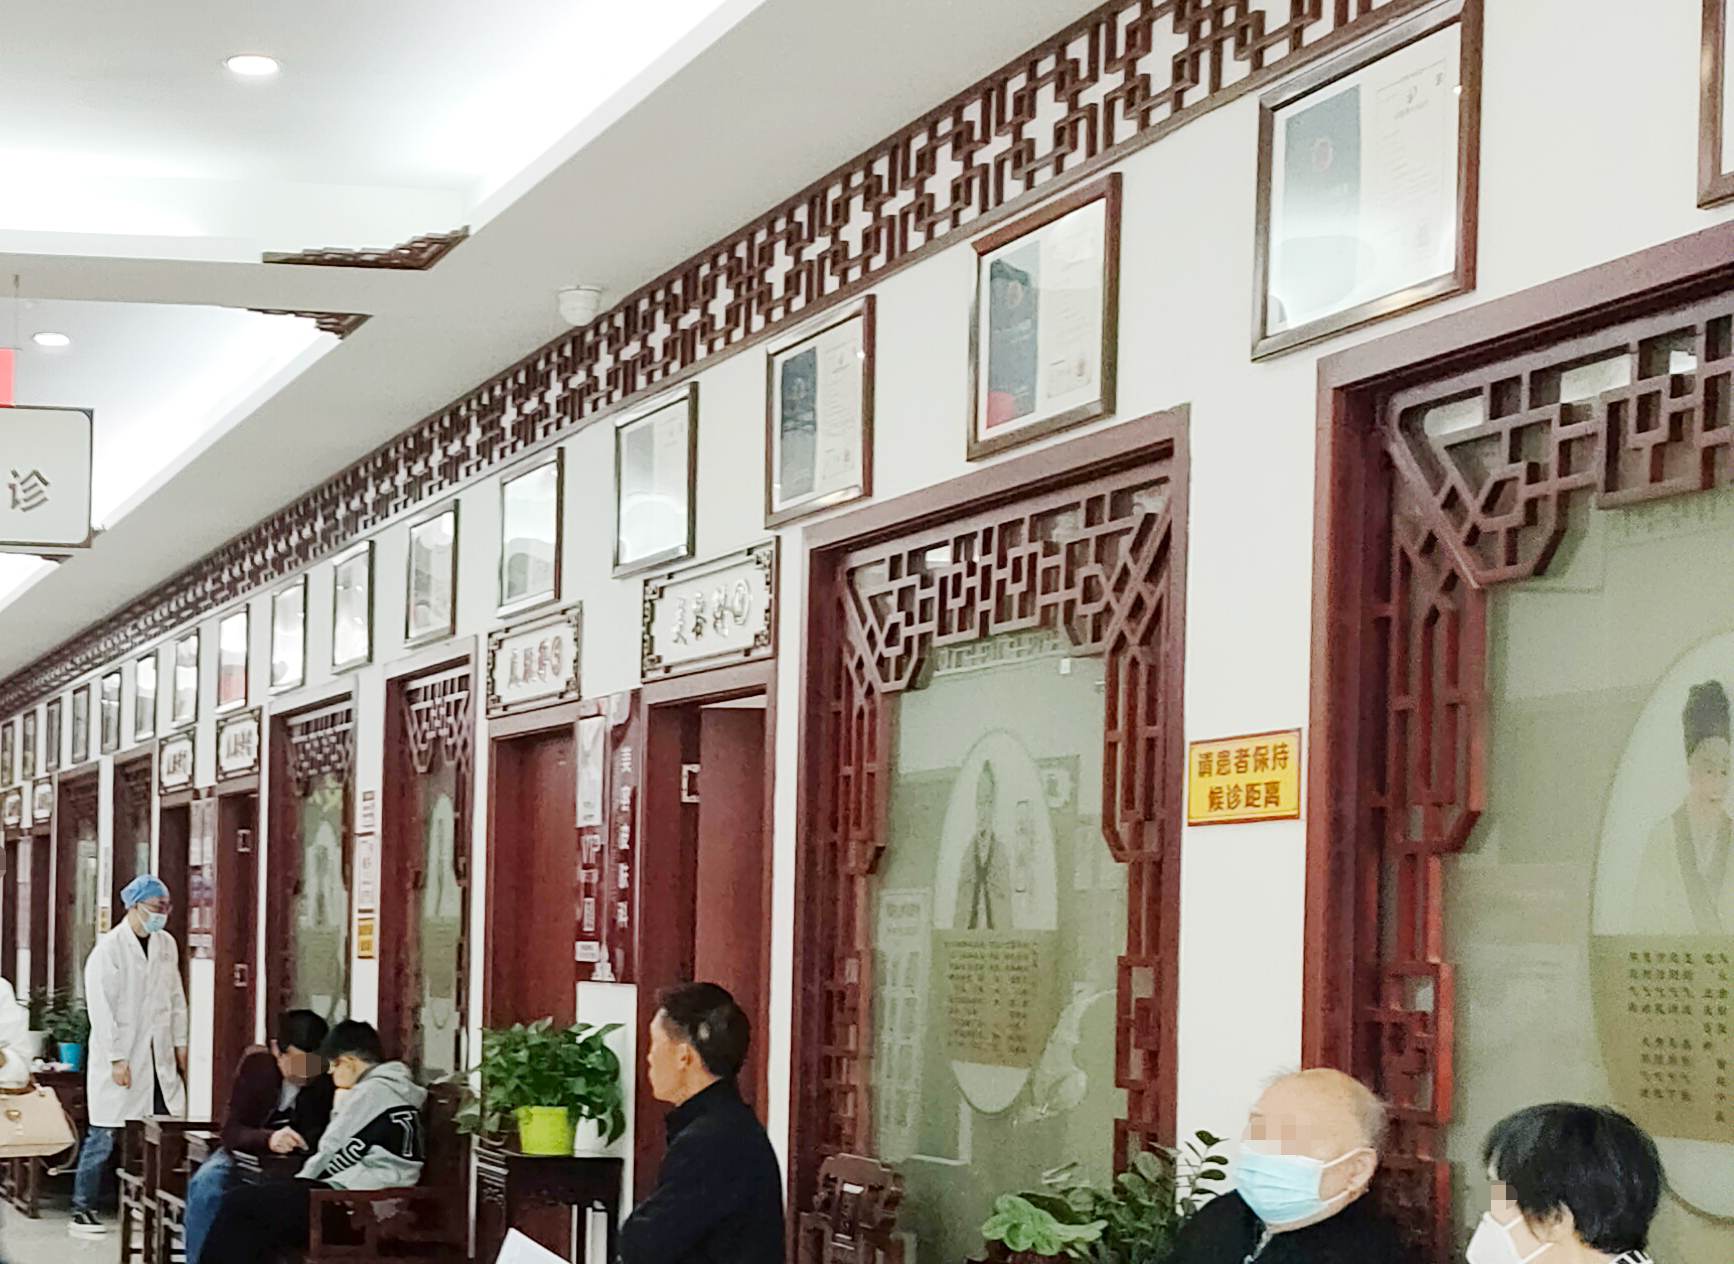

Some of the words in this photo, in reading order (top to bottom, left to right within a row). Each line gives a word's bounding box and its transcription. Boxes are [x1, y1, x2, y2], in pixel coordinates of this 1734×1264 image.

[1198, 742, 1289, 778] 请患者保持
[1208, 780, 1281, 812] 候诊距离
